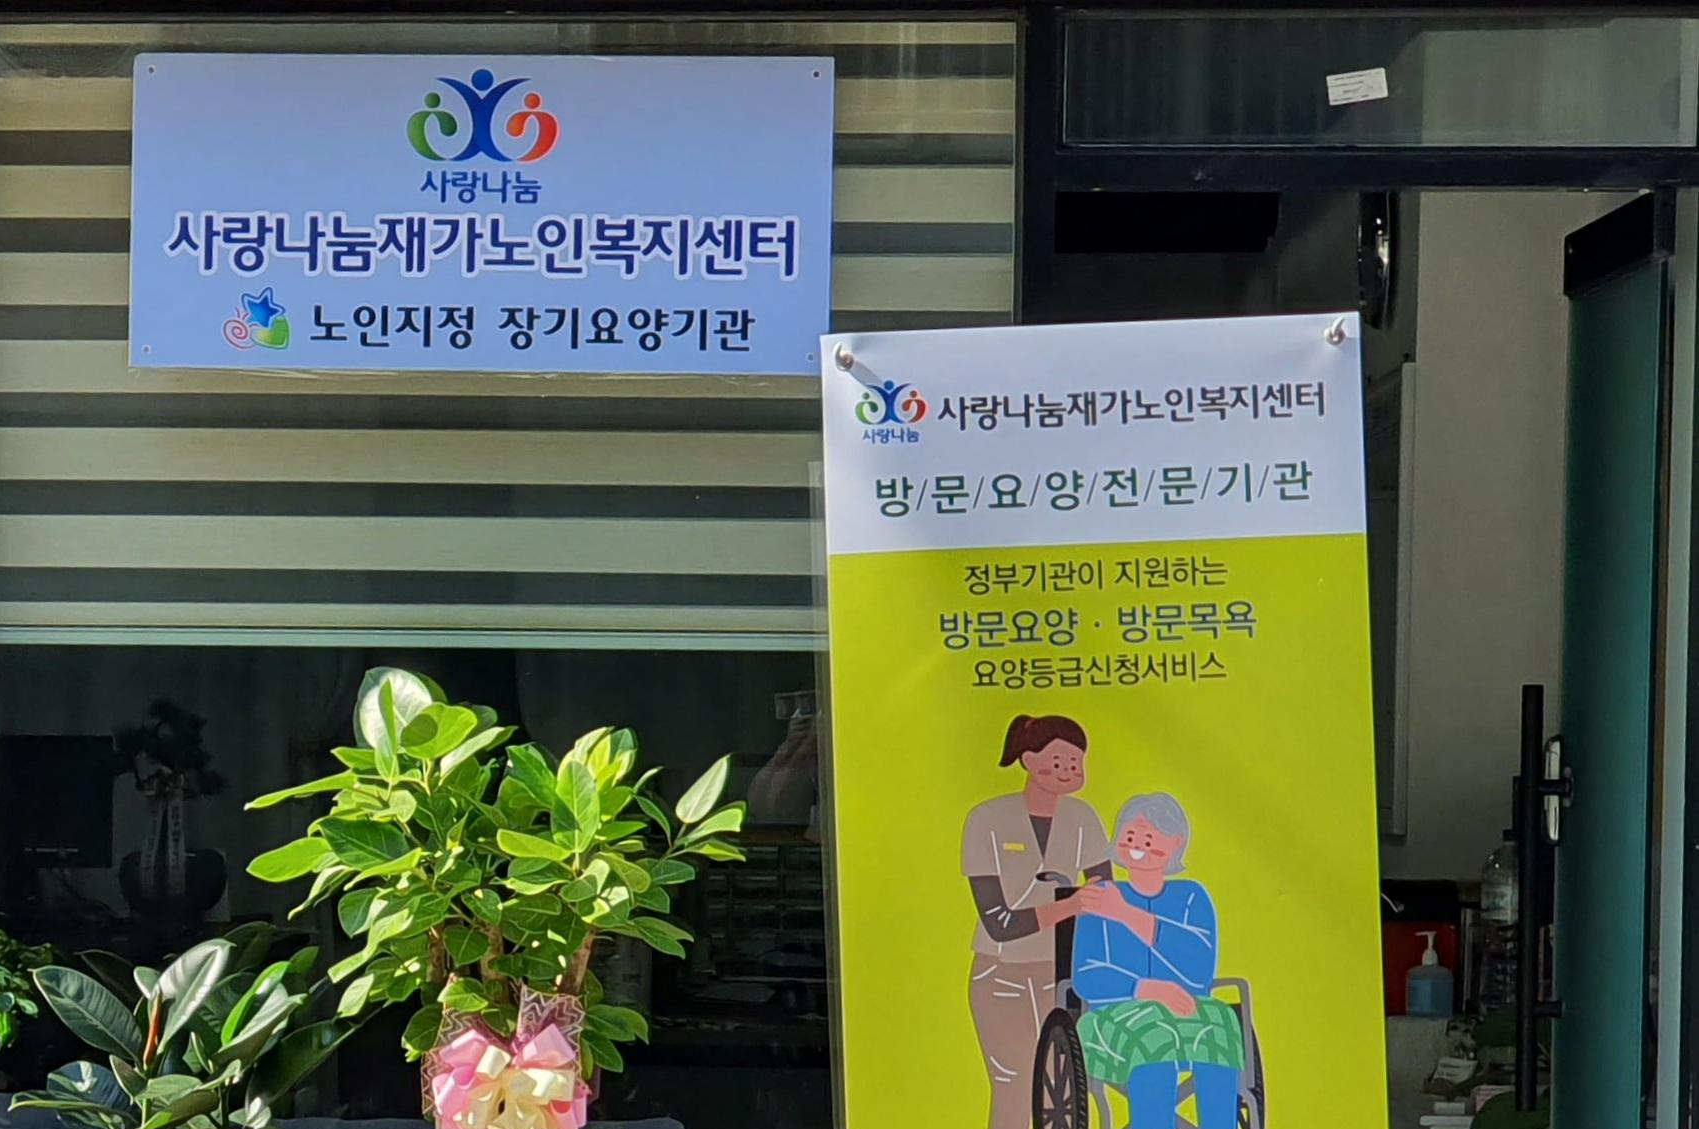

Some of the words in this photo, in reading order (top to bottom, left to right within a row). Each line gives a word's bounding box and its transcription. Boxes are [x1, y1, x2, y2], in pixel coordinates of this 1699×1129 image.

[420, 170, 542, 204] 사랑나눔
[168, 215, 795, 277] 사랑나눔재가노인복지센터
[310, 305, 474, 350] 노인지정
[498, 307, 756, 352] 장기요양기관
[937, 381, 1325, 431] 사랑나눔재가노인복지센터
[860, 427, 920, 444] 사랑나눔
[964, 559, 1103, 596] 정부기관이
[1114, 555, 1228, 589] 지원하는
[939, 607, 1079, 650] 방문요양
[1117, 600, 1257, 644] 방문목욕
[972, 651, 1227, 690] 요양등급신청서비스
